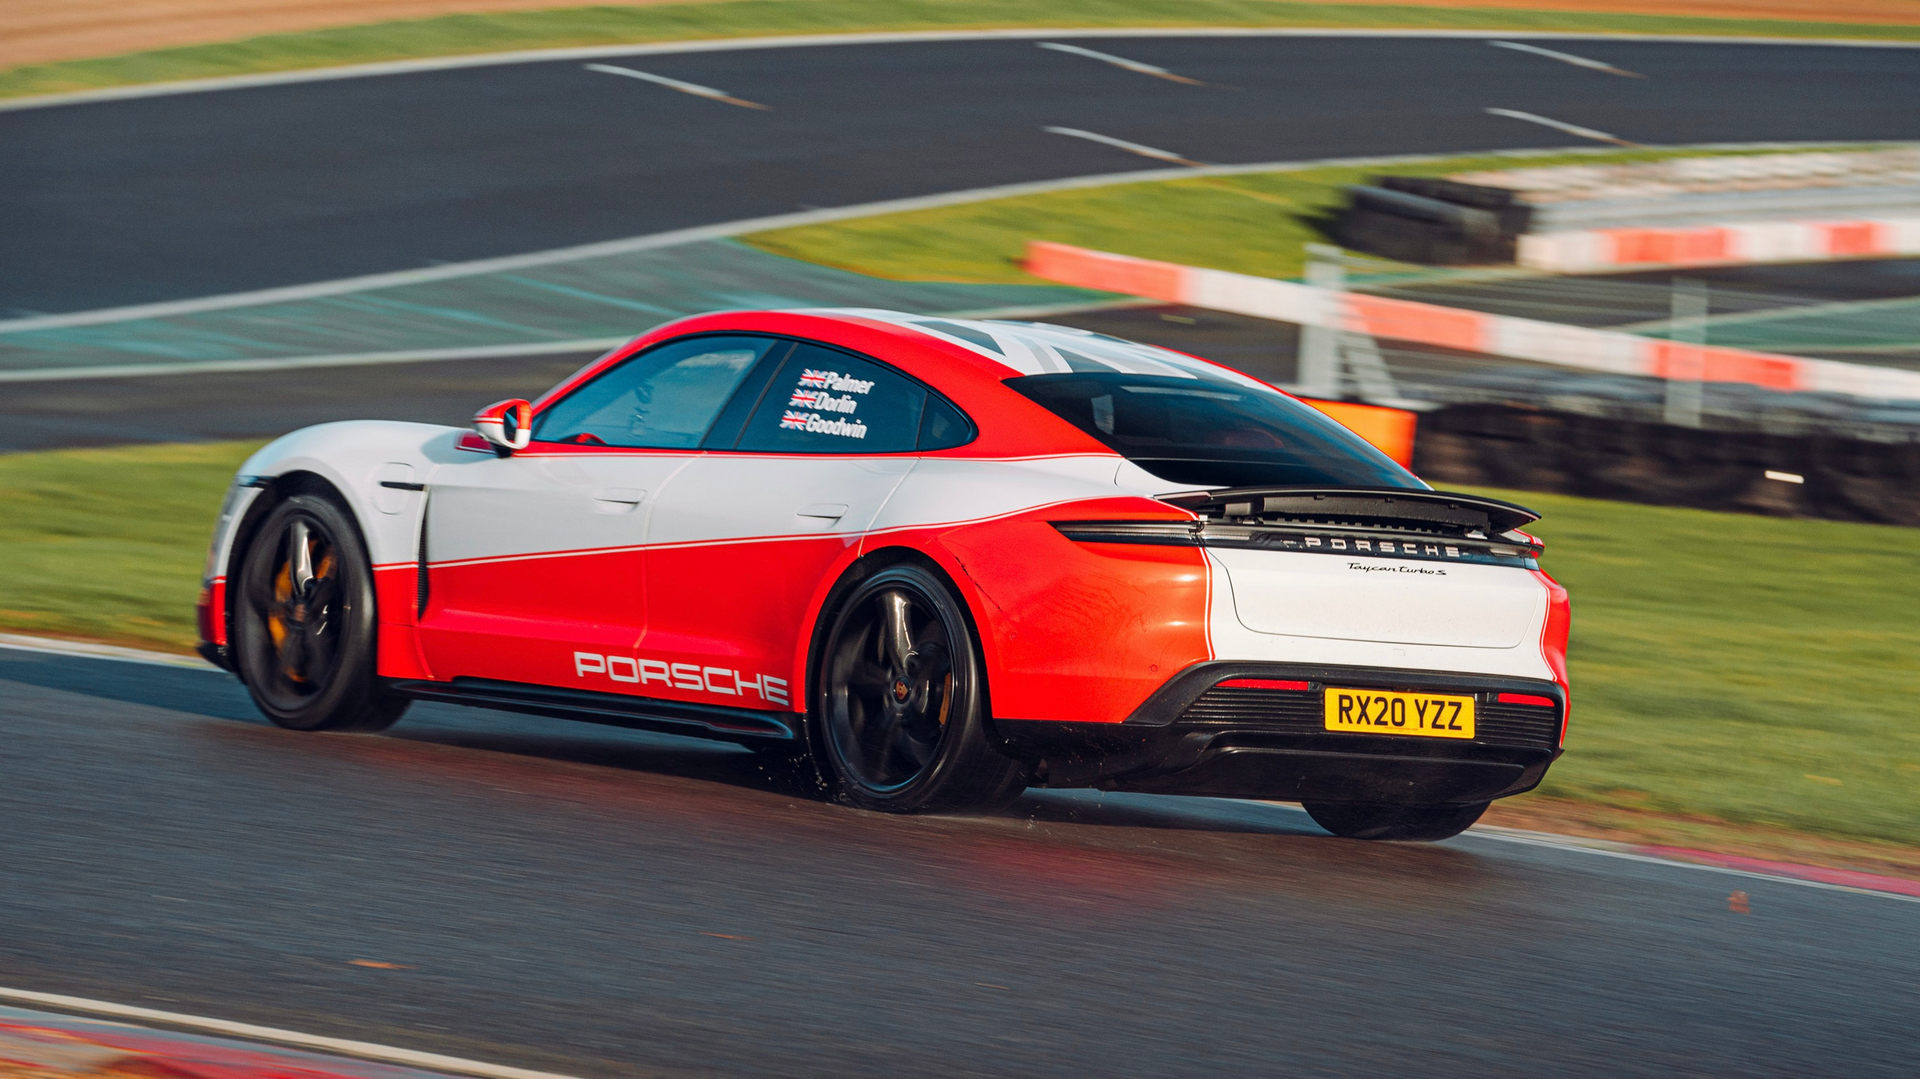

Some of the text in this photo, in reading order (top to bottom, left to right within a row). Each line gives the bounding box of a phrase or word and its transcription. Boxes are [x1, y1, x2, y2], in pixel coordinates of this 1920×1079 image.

[823, 371, 875, 395] Palmer
[805, 413, 868, 439] Goodwin
[1304, 536, 1460, 558] PORSCHE
[1347, 562, 1397, 573] Taycan
[573, 651, 789, 706] PORSCHE
[1338, 694, 1463, 731] RX20 YZZ
